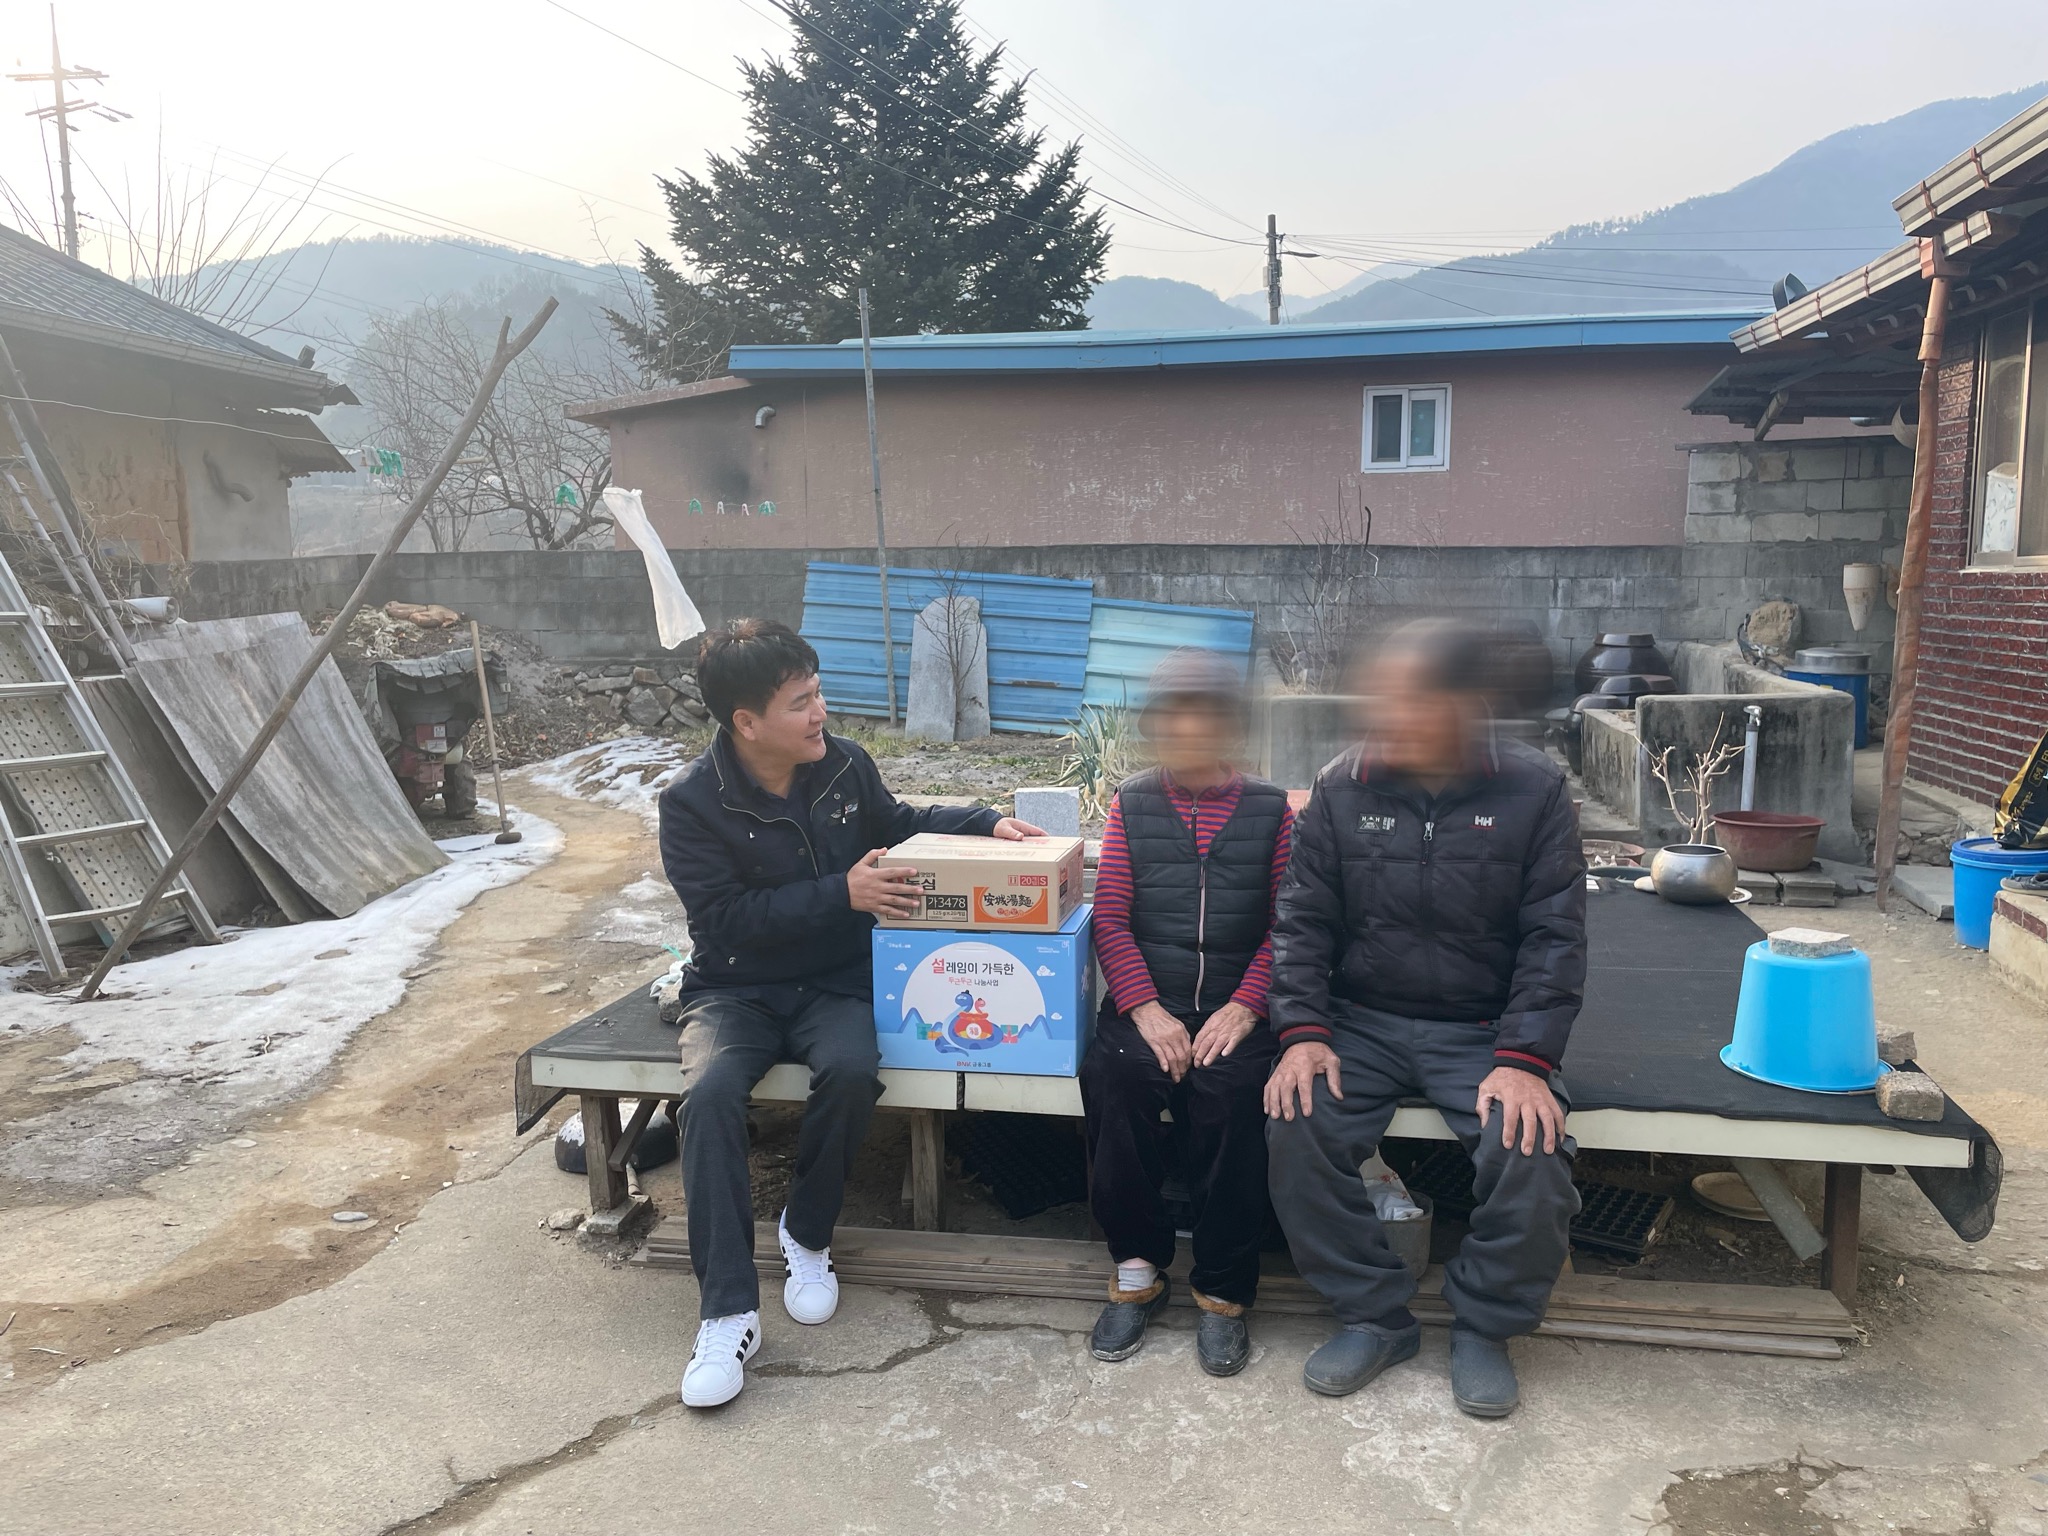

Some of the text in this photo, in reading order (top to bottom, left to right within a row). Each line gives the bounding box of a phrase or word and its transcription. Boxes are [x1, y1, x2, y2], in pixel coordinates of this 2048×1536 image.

[928, 897, 966, 908] 가3478
[932, 958, 1015, 976] 설레임이 가득한
